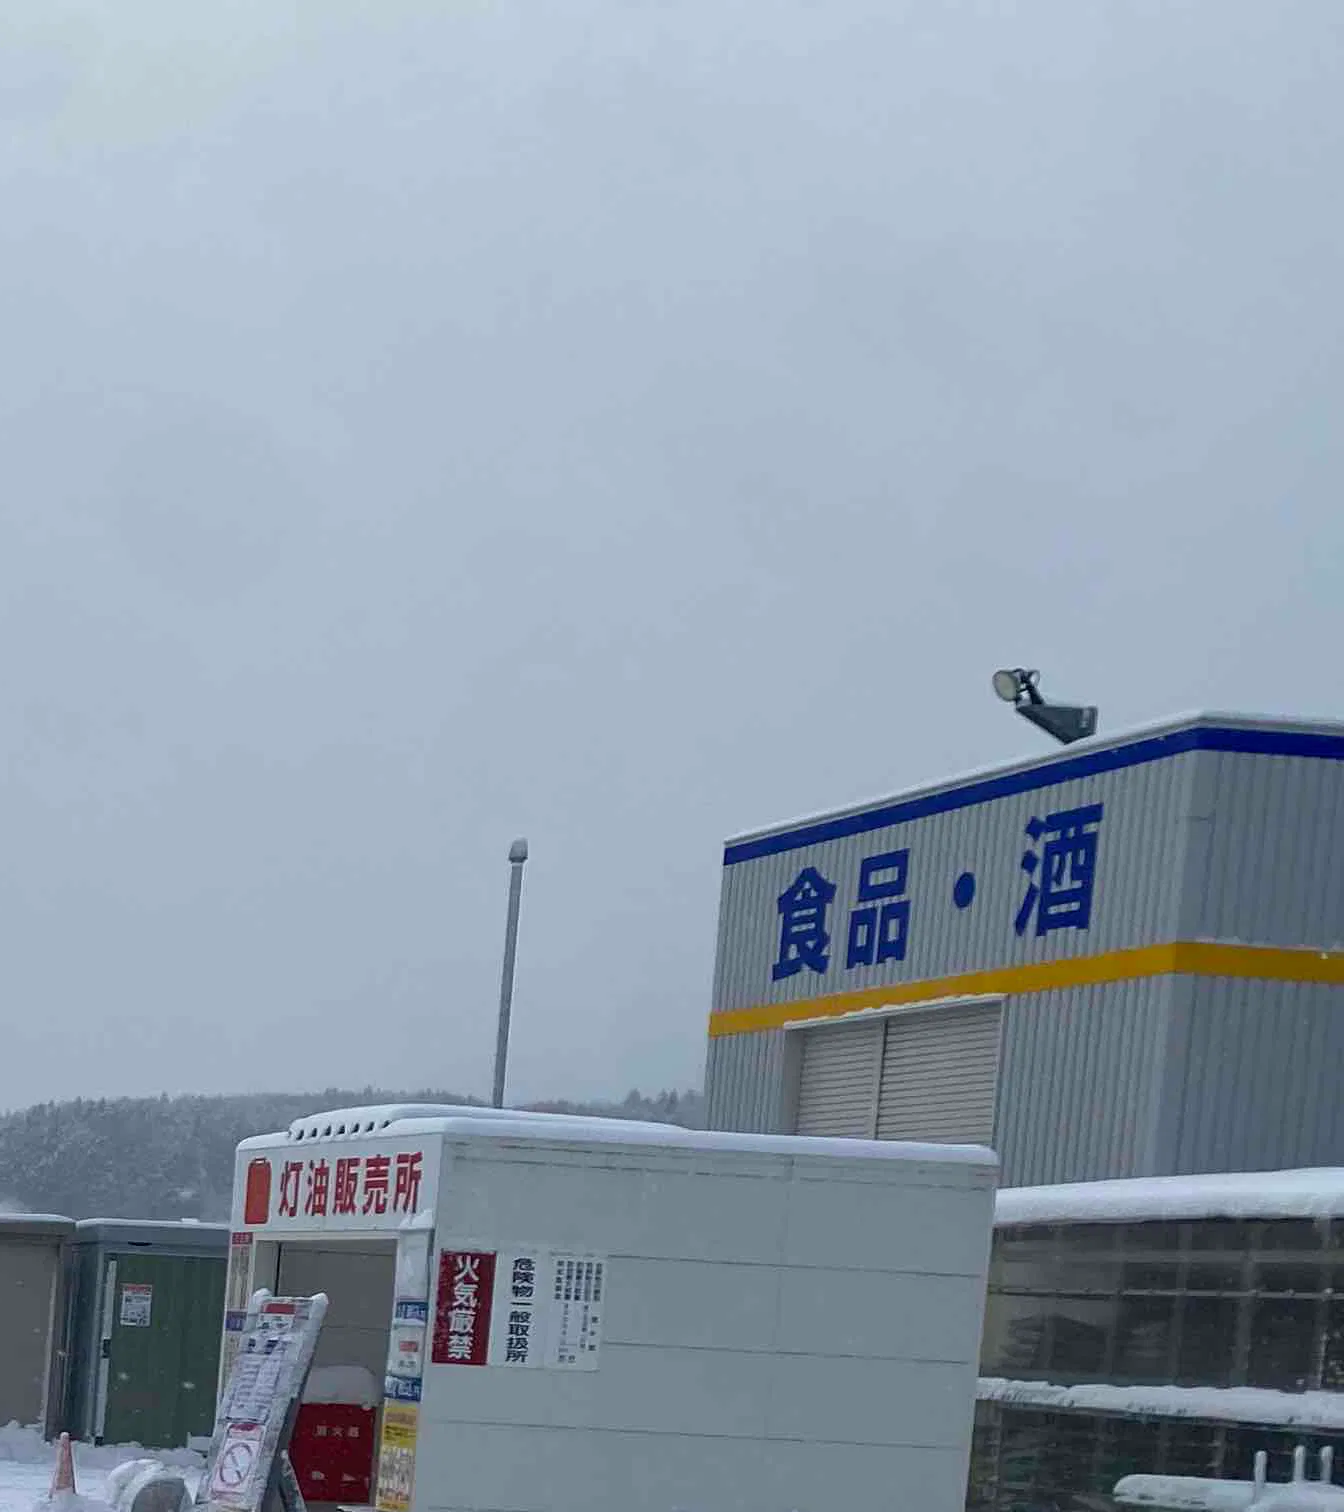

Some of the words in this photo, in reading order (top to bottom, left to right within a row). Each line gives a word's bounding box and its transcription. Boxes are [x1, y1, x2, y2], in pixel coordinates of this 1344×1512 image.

[772, 803, 1104, 981] 食品・酒
[278, 1151, 423, 1217] 灯油販売所
[447, 1255, 480, 1360] 火気厳禁
[504, 1257, 536, 1363] 危険物一般取扱所
